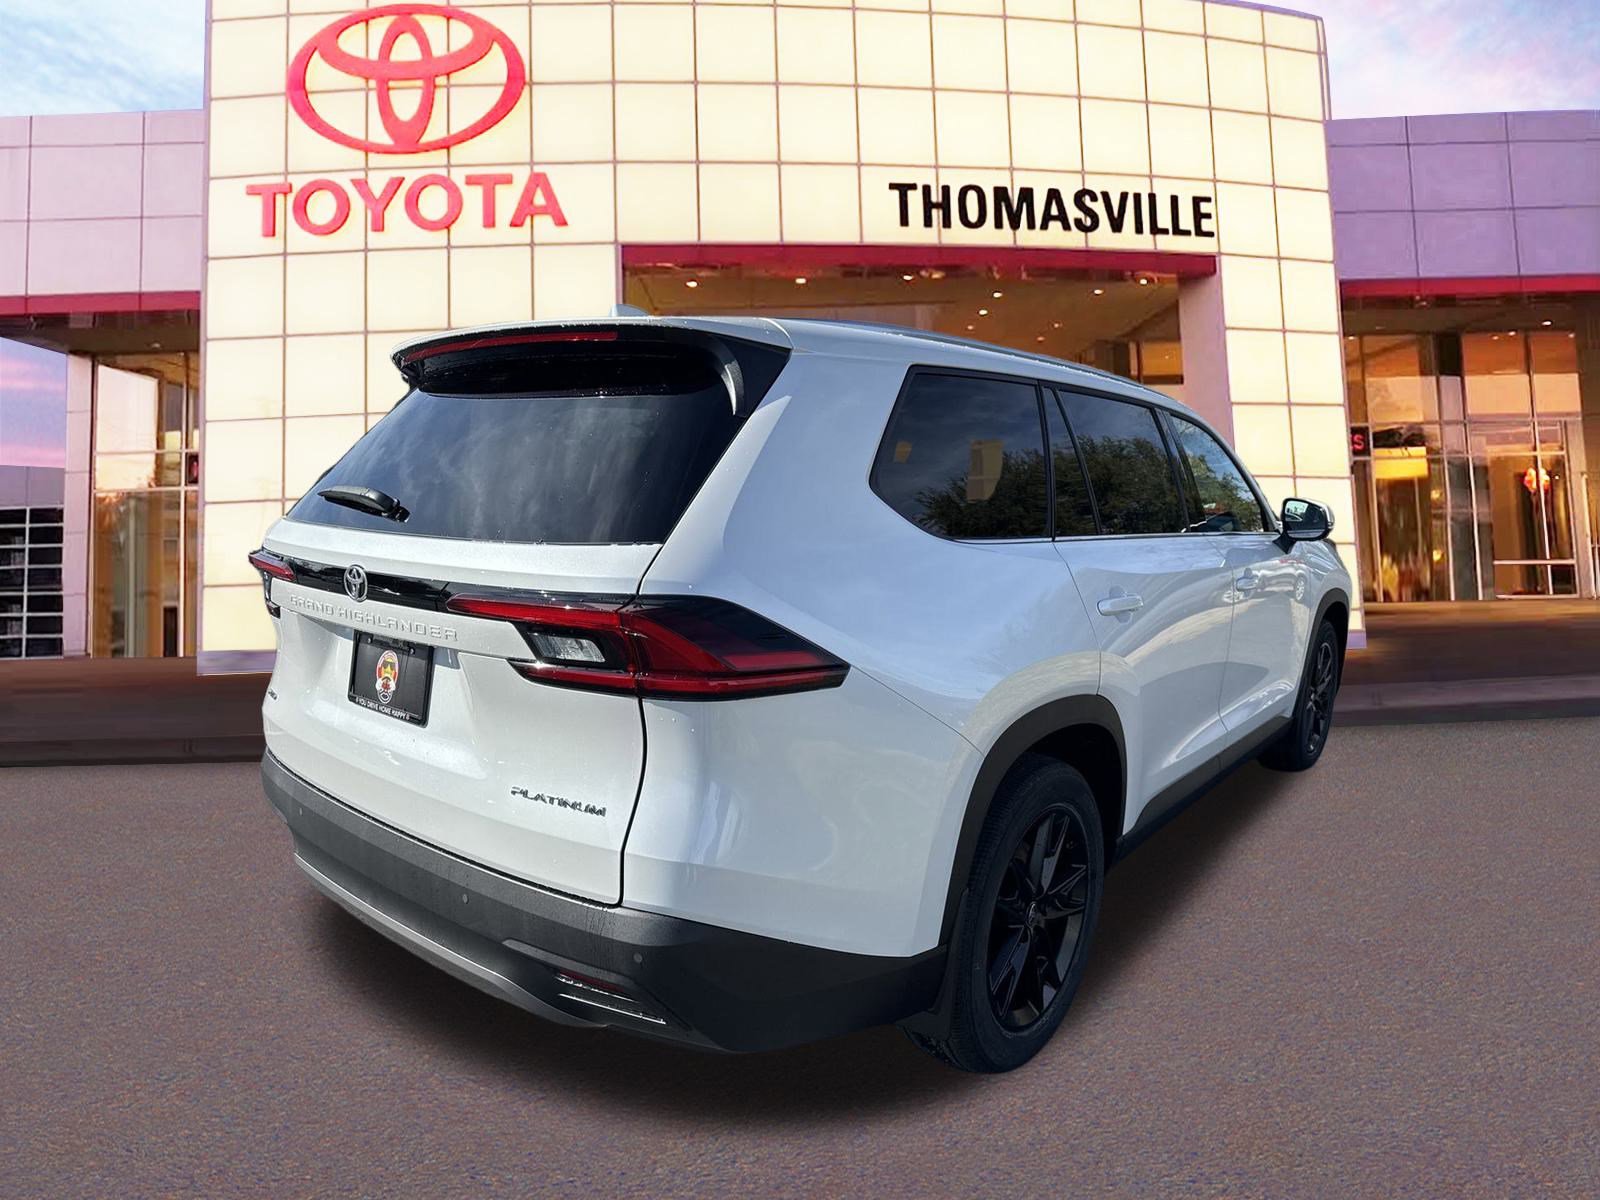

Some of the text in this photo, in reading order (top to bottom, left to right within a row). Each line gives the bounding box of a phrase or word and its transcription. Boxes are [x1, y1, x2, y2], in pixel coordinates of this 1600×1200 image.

[246, 171, 569, 237] TOYOTA
[888, 182, 1216, 238] THOMASVILLE
[290, 594, 459, 642] GRAND HIGHLANDER
[510, 786, 607, 817] PLATINUM
